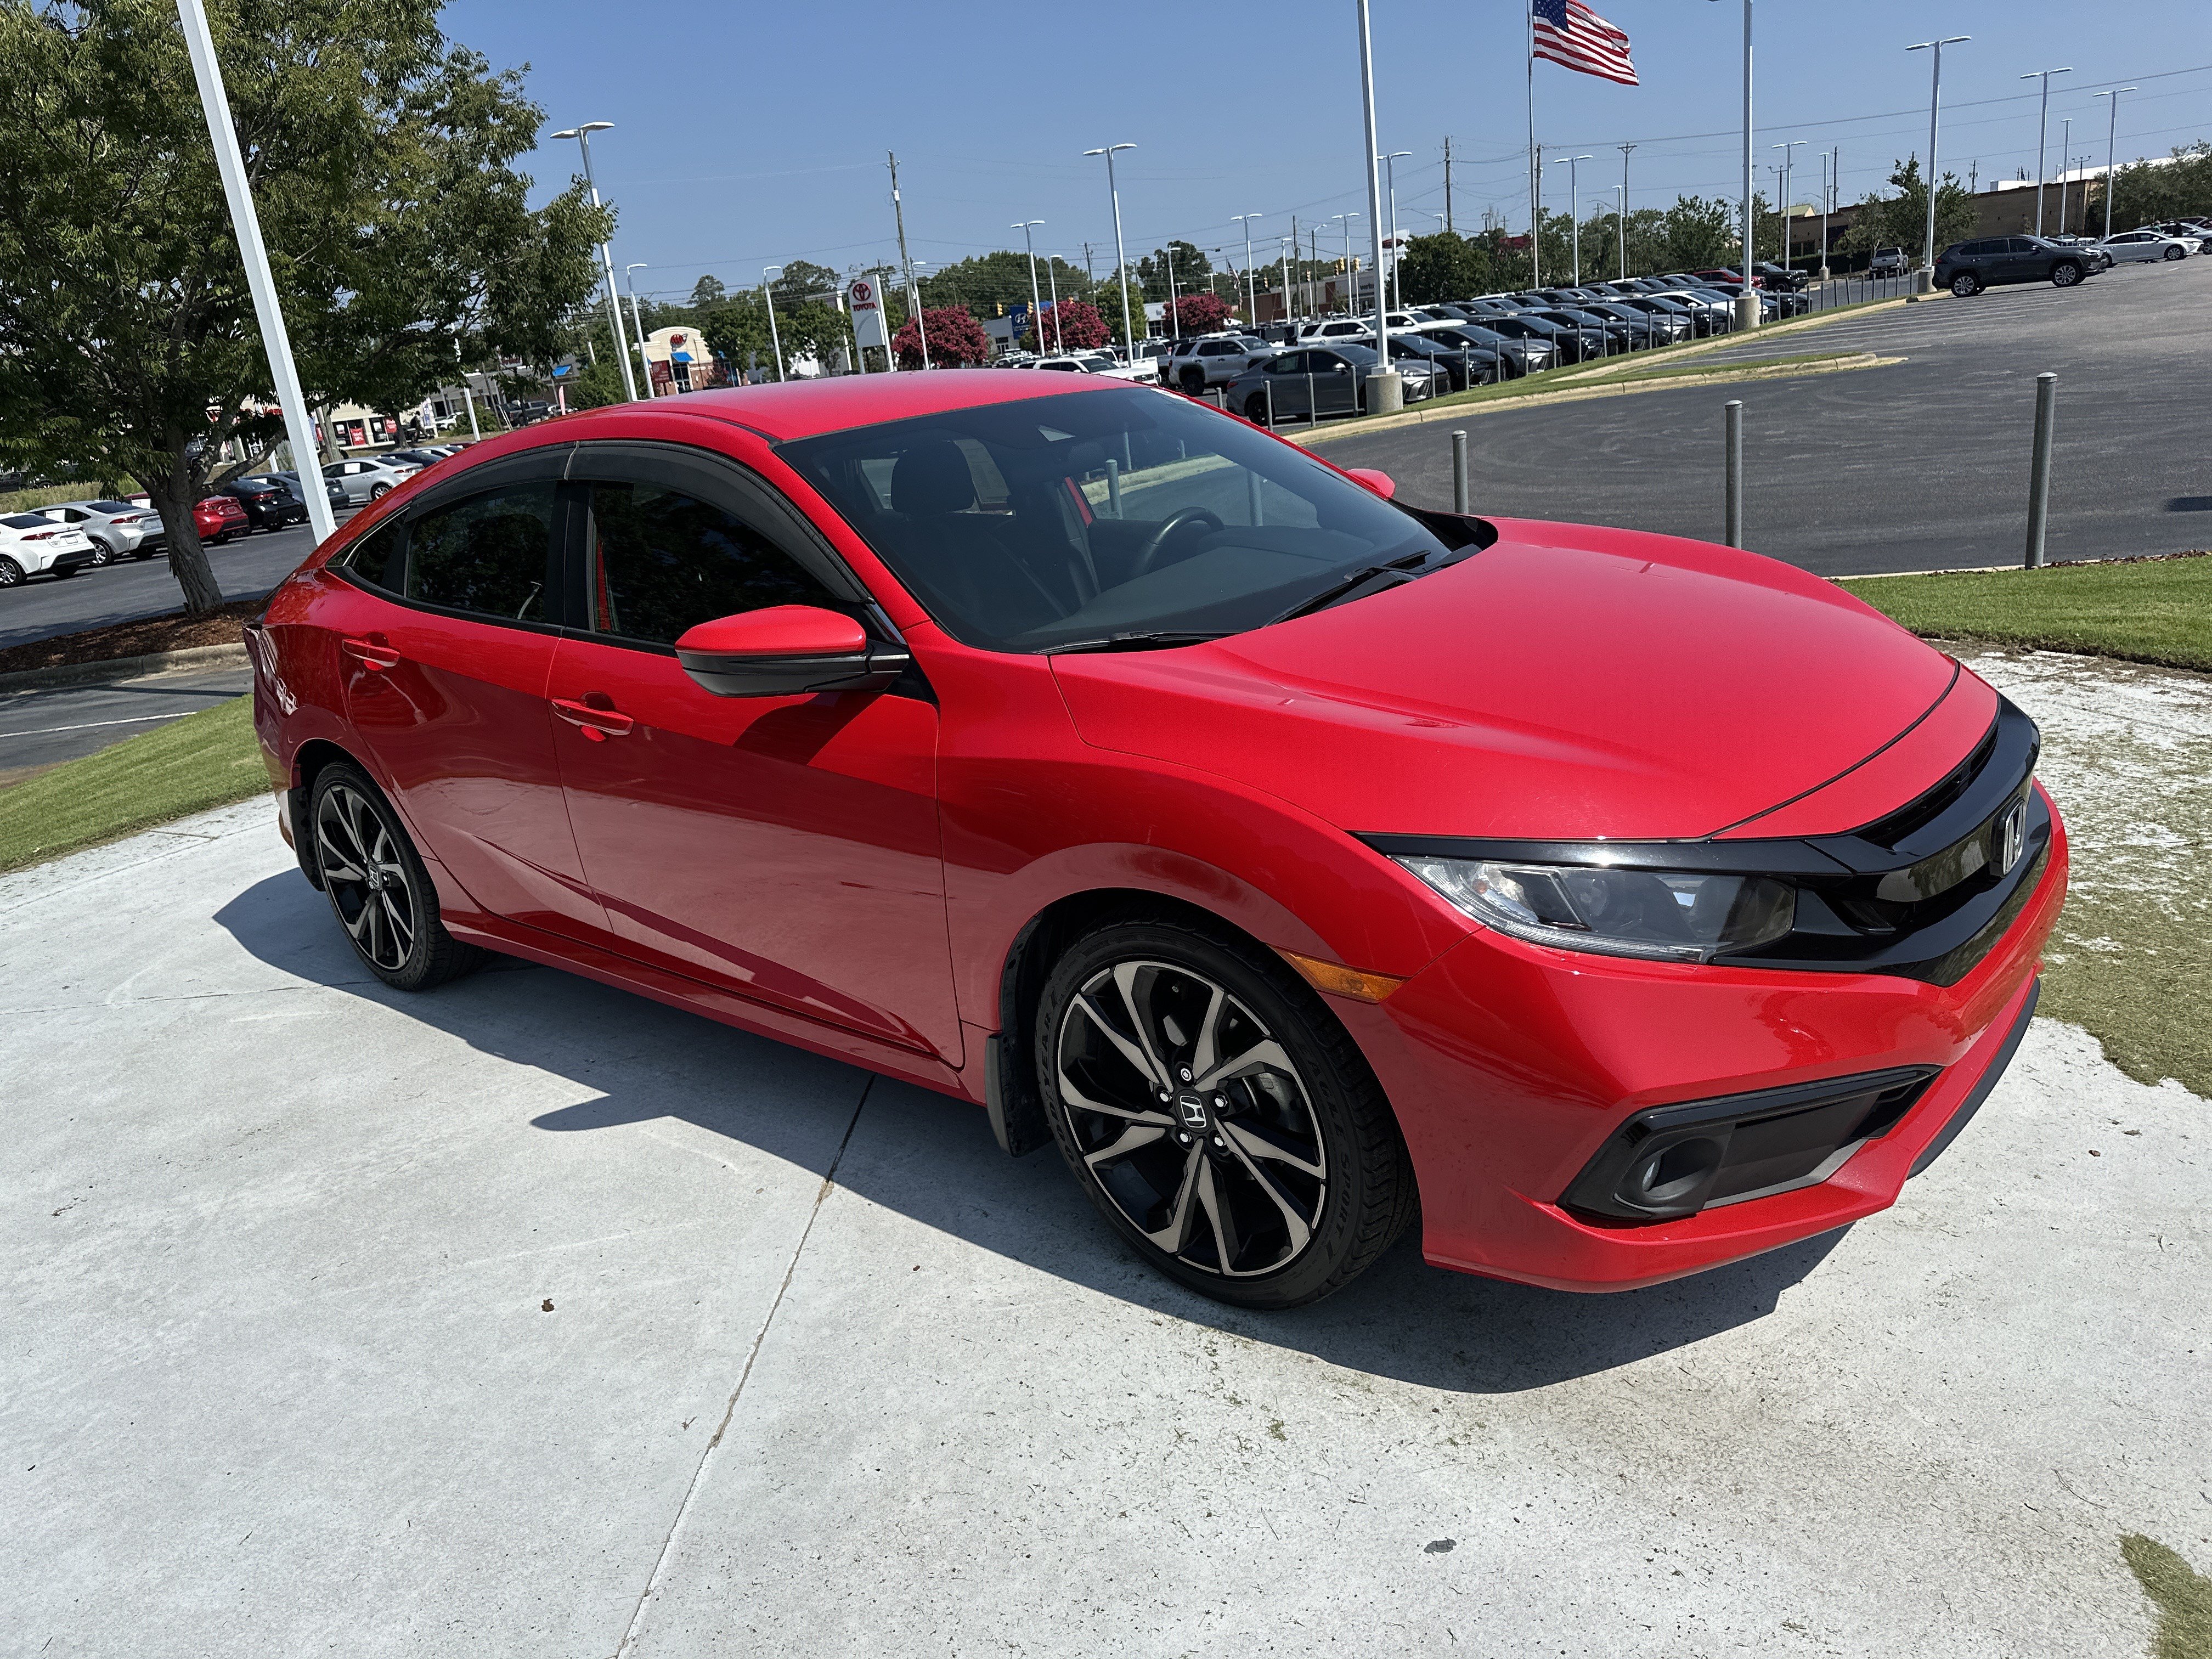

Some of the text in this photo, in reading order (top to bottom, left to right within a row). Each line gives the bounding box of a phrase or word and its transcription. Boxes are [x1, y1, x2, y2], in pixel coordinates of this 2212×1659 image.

[852, 302, 877, 312] TOYOTA
[1041, 1013, 1087, 1183] GOODYEAR
[1300, 1045, 1351, 1240] EAGLE SPORT
